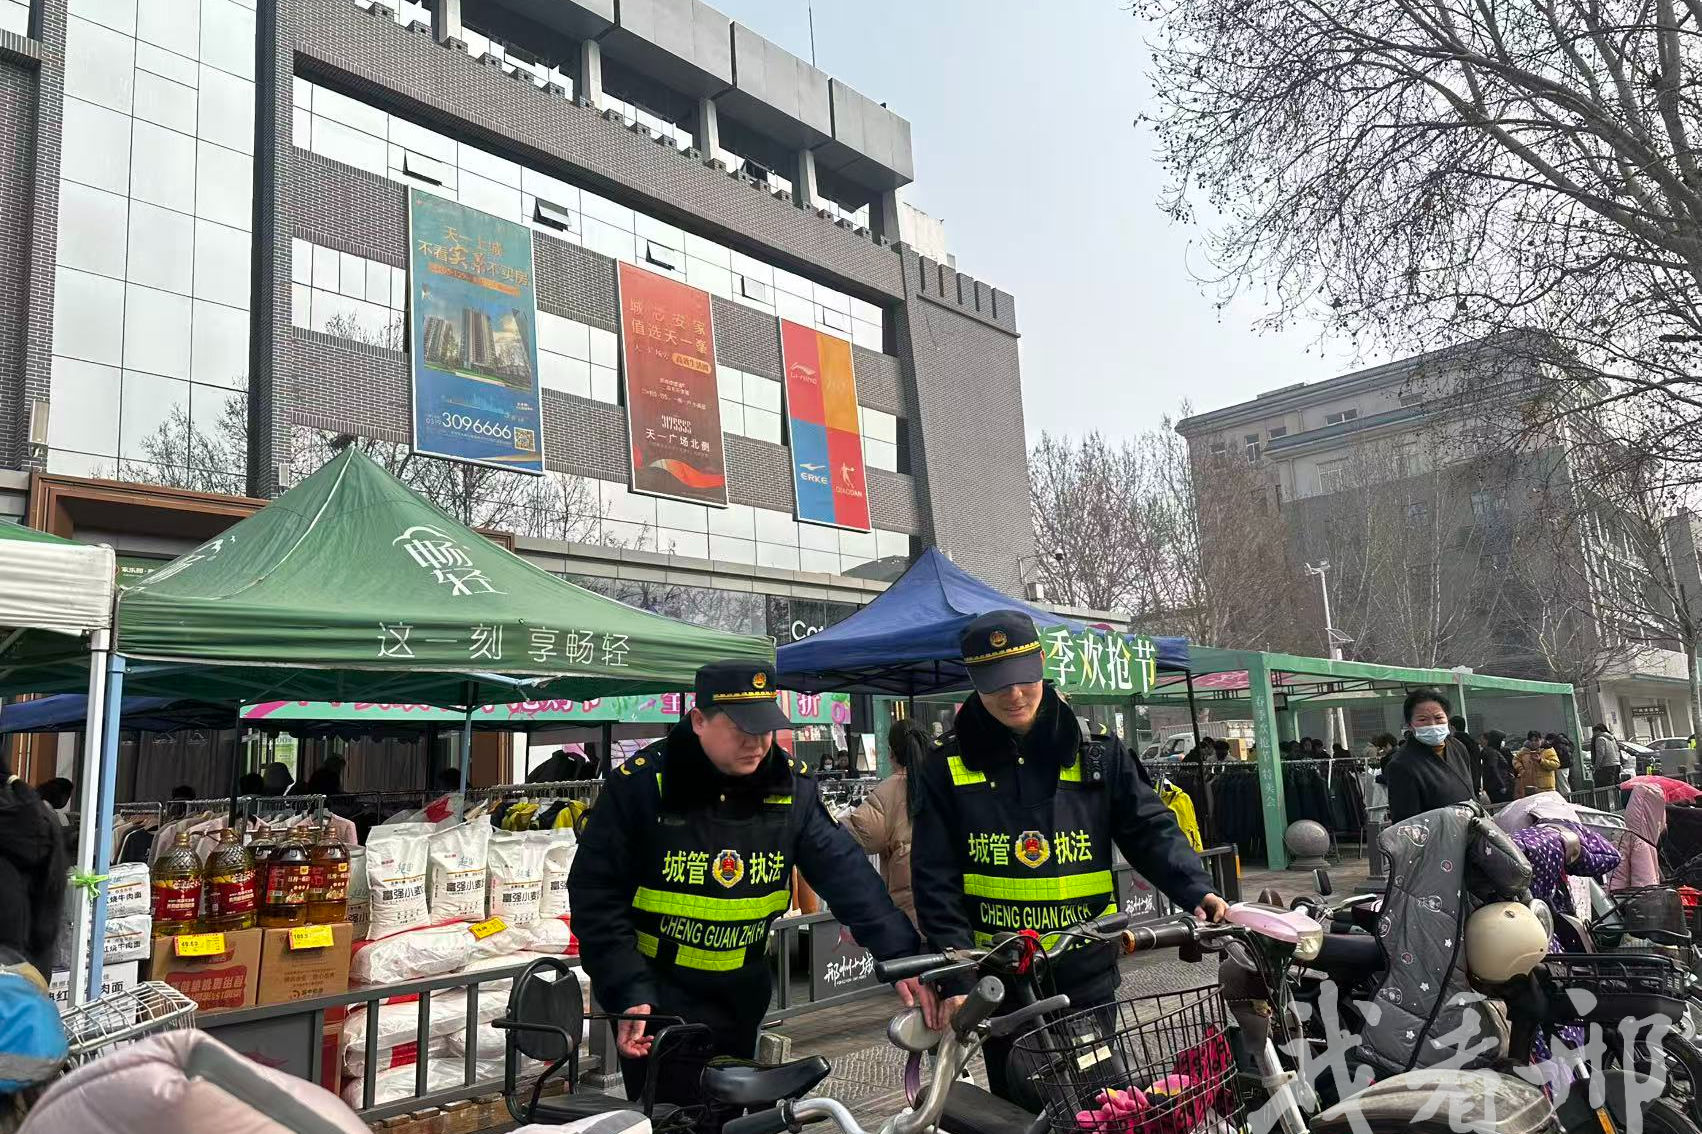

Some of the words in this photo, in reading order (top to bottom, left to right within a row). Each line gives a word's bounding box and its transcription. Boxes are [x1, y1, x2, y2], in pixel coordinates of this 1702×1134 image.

[442, 411, 512, 439] 3096666
[646, 427, 711, 453] 天一广场北侧
[377, 621, 504, 660] 这一刻
[527, 626, 630, 667] 享畅轻
[968, 832, 1010, 866] 城管
[1054, 829, 1093, 865] 执法
[662, 850, 709, 885] 城管
[749, 851, 784, 885] 执法
[106, 890, 142, 904] 烧牛肉面
[980, 902, 1021, 929] CHENG
[1023, 906, 1059, 930] GUAN
[1060, 905, 1078, 927] ZHI
[660, 915, 703, 944] CHENG
[704, 924, 740, 948] GUAN
[738, 923, 756, 946] ZHI
